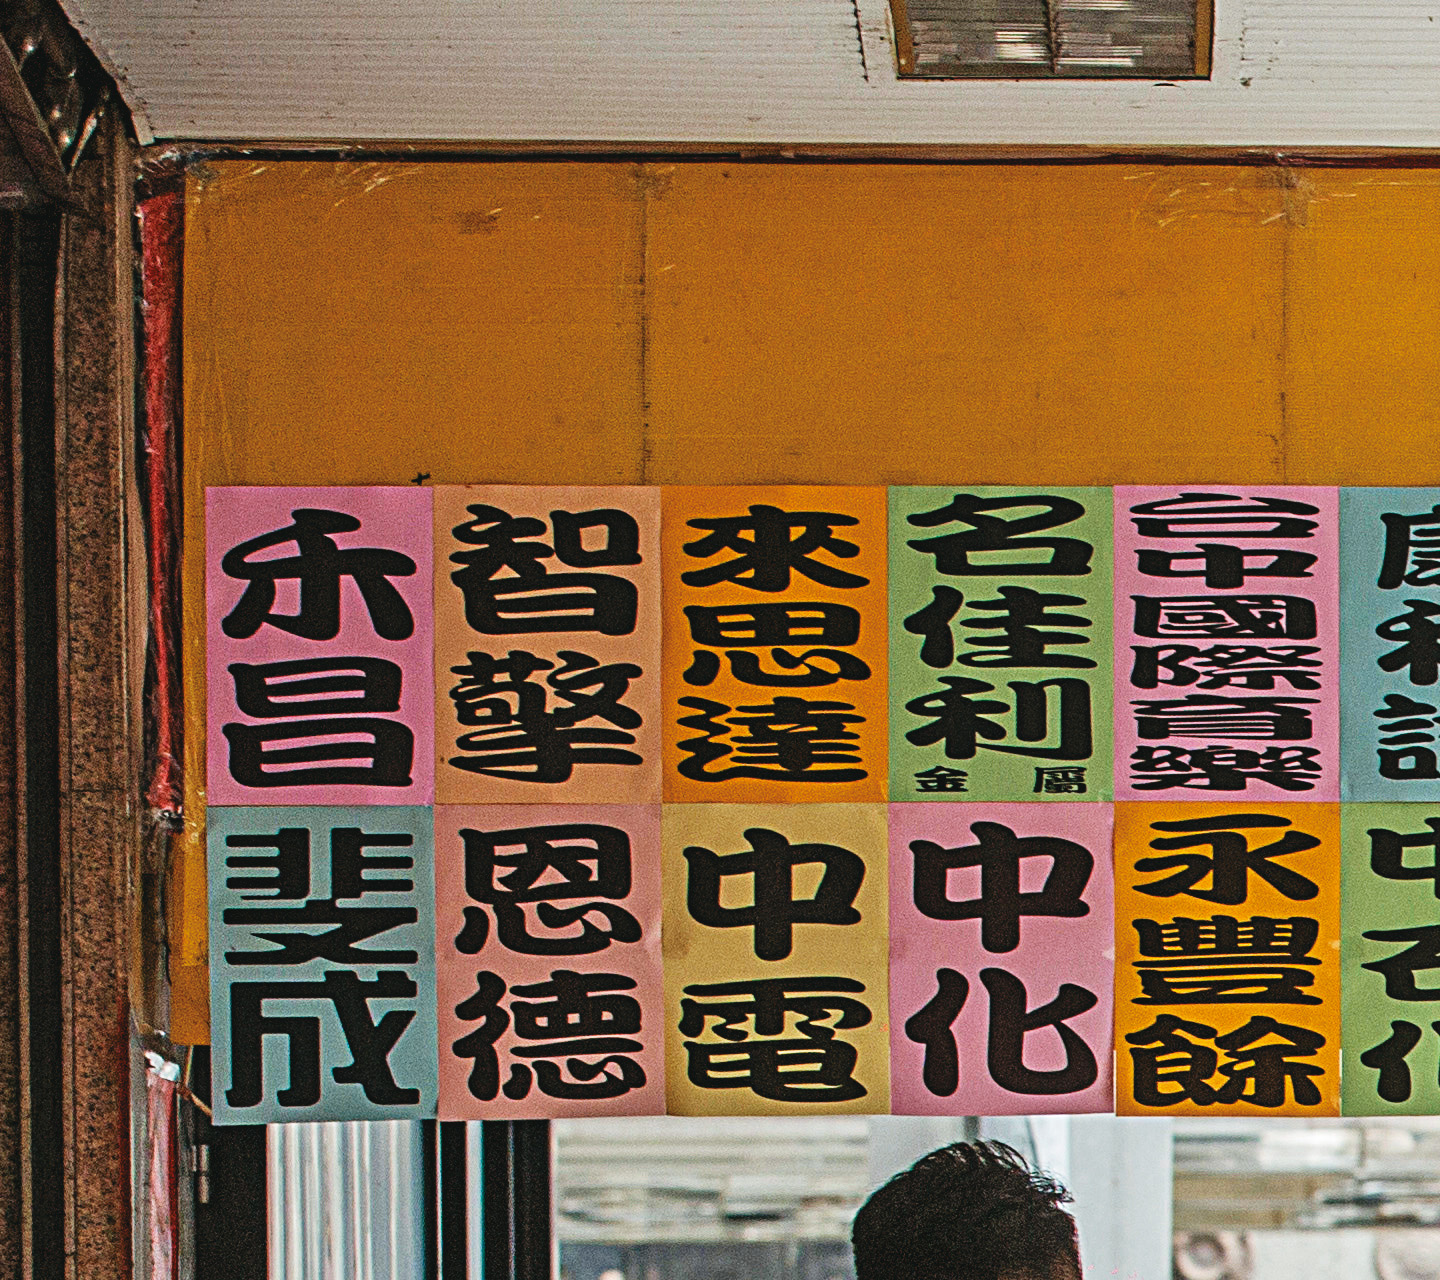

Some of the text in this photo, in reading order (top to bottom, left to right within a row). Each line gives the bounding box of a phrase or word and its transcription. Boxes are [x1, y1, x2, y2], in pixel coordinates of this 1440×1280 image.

[222, 509, 416, 787] 禾昌
[449, 505, 643, 783] 智擎
[677, 505, 871, 782] 來思達
[904, 494, 1097, 760] 名佳利
[1130, 493, 1322, 790] 台中國際育樂
[453, 824, 646, 1101] 恩德
[679, 829, 871, 1102] 中電
[905, 822, 1097, 1096] 中化
[1133, 814, 1325, 1107] 永豐餘
